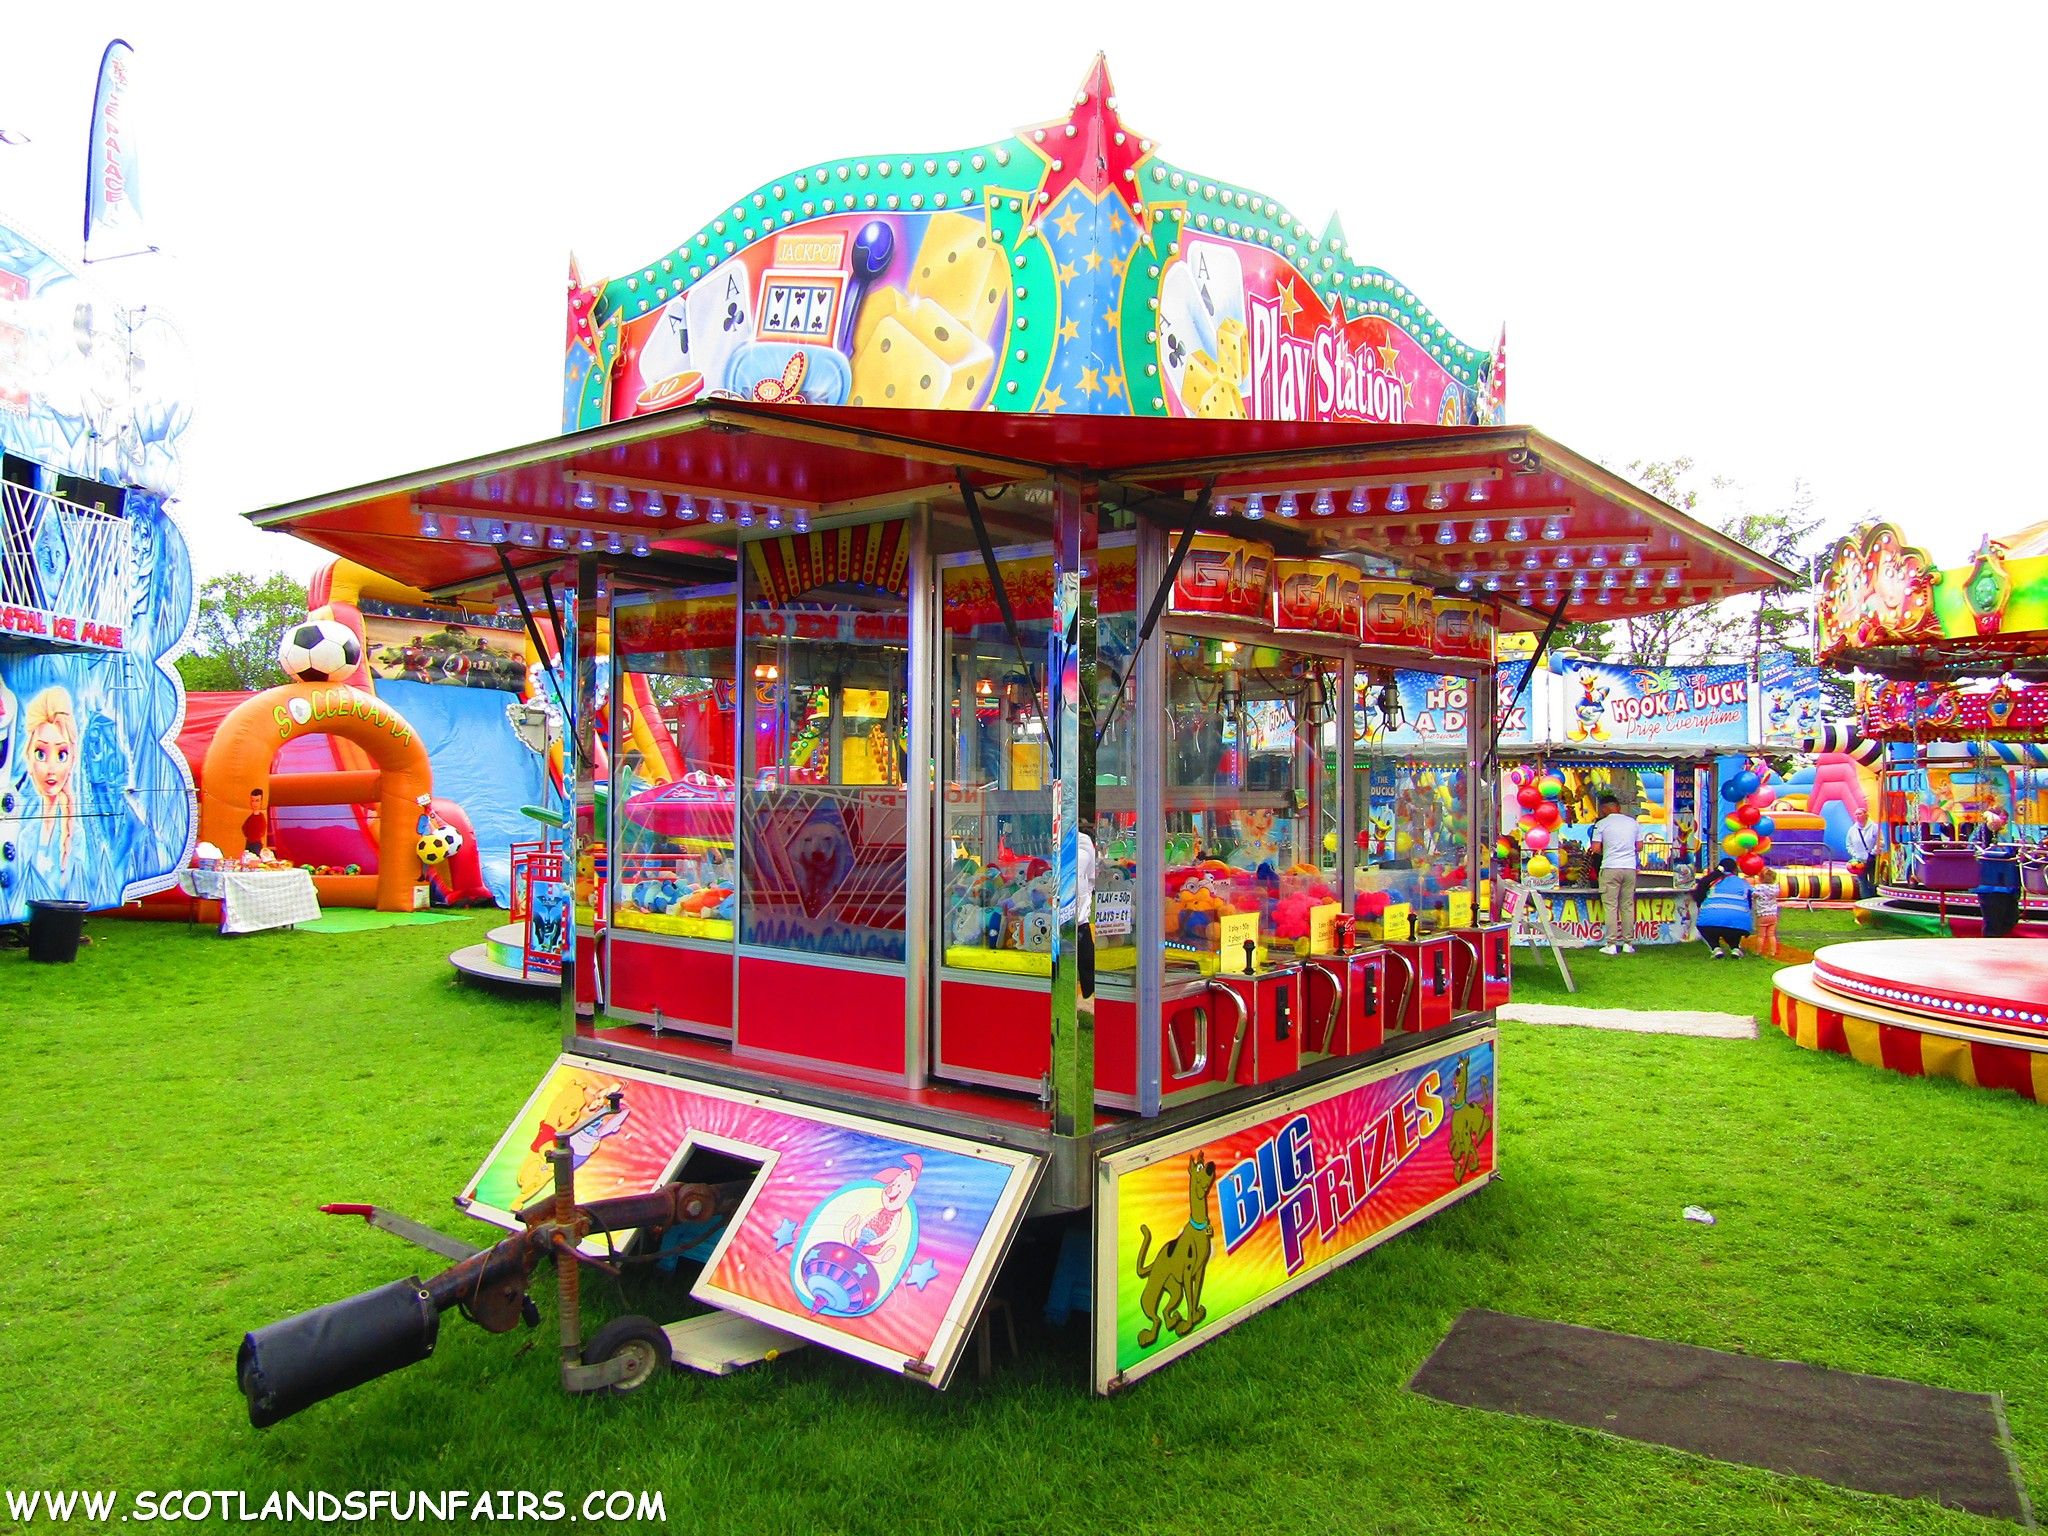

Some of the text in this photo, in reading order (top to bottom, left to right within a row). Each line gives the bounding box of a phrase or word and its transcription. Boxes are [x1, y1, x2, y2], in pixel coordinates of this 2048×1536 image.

[104, 121, 123, 203] PALACE
[779, 244, 840, 262] JACKPOT
[1198, 252, 1210, 280] A
[727, 274, 739, 300] A
[669, 314, 682, 335] A
[1251, 299, 1403, 423] Play Station
[654, 378, 679, 400] 10
[763, 386, 776, 397] 50
[0, 605, 123, 648] STAL ICE MAZE
[1762, 664, 1787, 678] Prize
[1426, 685, 1514, 709] HOK
[1611, 680, 1747, 723] HOOK A DUCK
[273, 689, 411, 746] SOCCERAMA
[1414, 711, 1436, 733] A
[1626, 707, 1741, 741] Prize Everytime
[1417, 732, 1463, 740] Everyone
[1370, 786, 1395, 797] DUCKS
[1377, 776, 1388, 784] THE
[1097, 893, 1113, 904] PLAY
[1119, 891, 1130, 904] 50p
[1095, 910, 1115, 922] PLAYS
[1561, 898, 1579, 922] A
[1216, 1114, 1315, 1255] BIG
[1278, 1070, 1446, 1276] PRIZES
